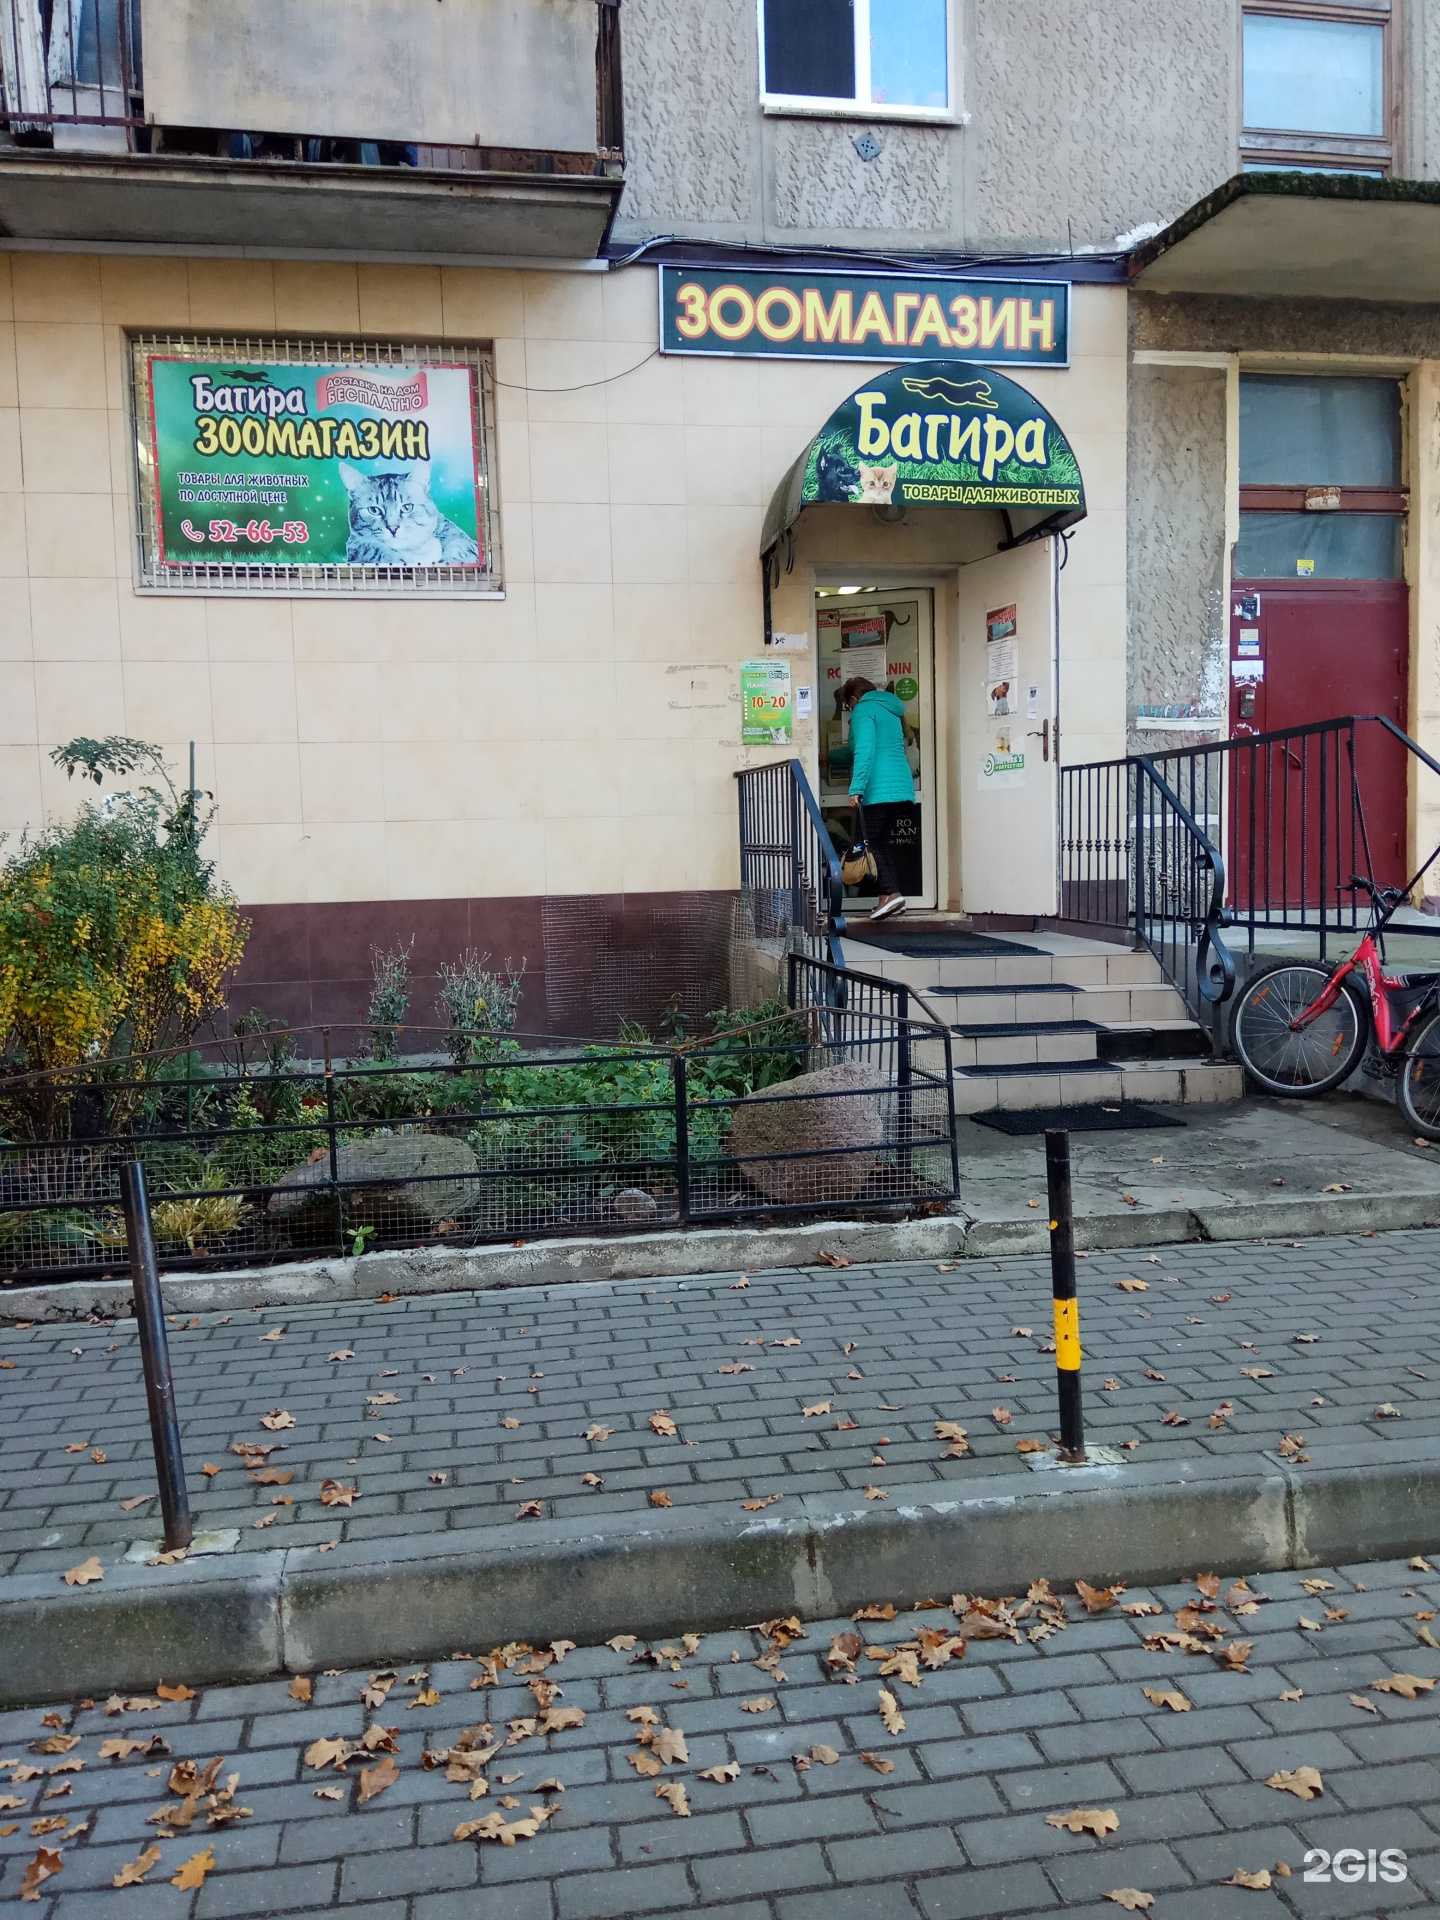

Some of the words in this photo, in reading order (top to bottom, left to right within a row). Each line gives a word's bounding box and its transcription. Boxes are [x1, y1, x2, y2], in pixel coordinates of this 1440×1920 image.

[676, 283, 1055, 352] ЗООМАГАЗИН
[190, 375, 307, 418] Багира
[326, 377, 379, 394] ДОСТАВКА
[380, 385, 396, 396] НА
[396, 383, 420, 396] ДОМ
[327, 388, 423, 412] БЕСПЛАТНО
[196, 416, 430, 460] ЗООМАГАЗИН
[855, 392, 1048, 481] Багира
[178, 472, 220, 486] ТОВАРЫ
[223, 473, 245, 486] ДЛЯ
[248, 474, 309, 488] ЖИВОТНЫХ
[179, 489, 195, 502] ПО
[197, 489, 258, 503] ДОСТУПНОЙ
[260, 491, 288, 505] ЦЕНЕ
[903, 485, 962, 501] ТОВАРЫ
[963, 486, 995, 504] ДЛЯ
[995, 487, 1079, 504] ЖИВОТНЫХ
[208, 520, 309, 543] 52-66-53
